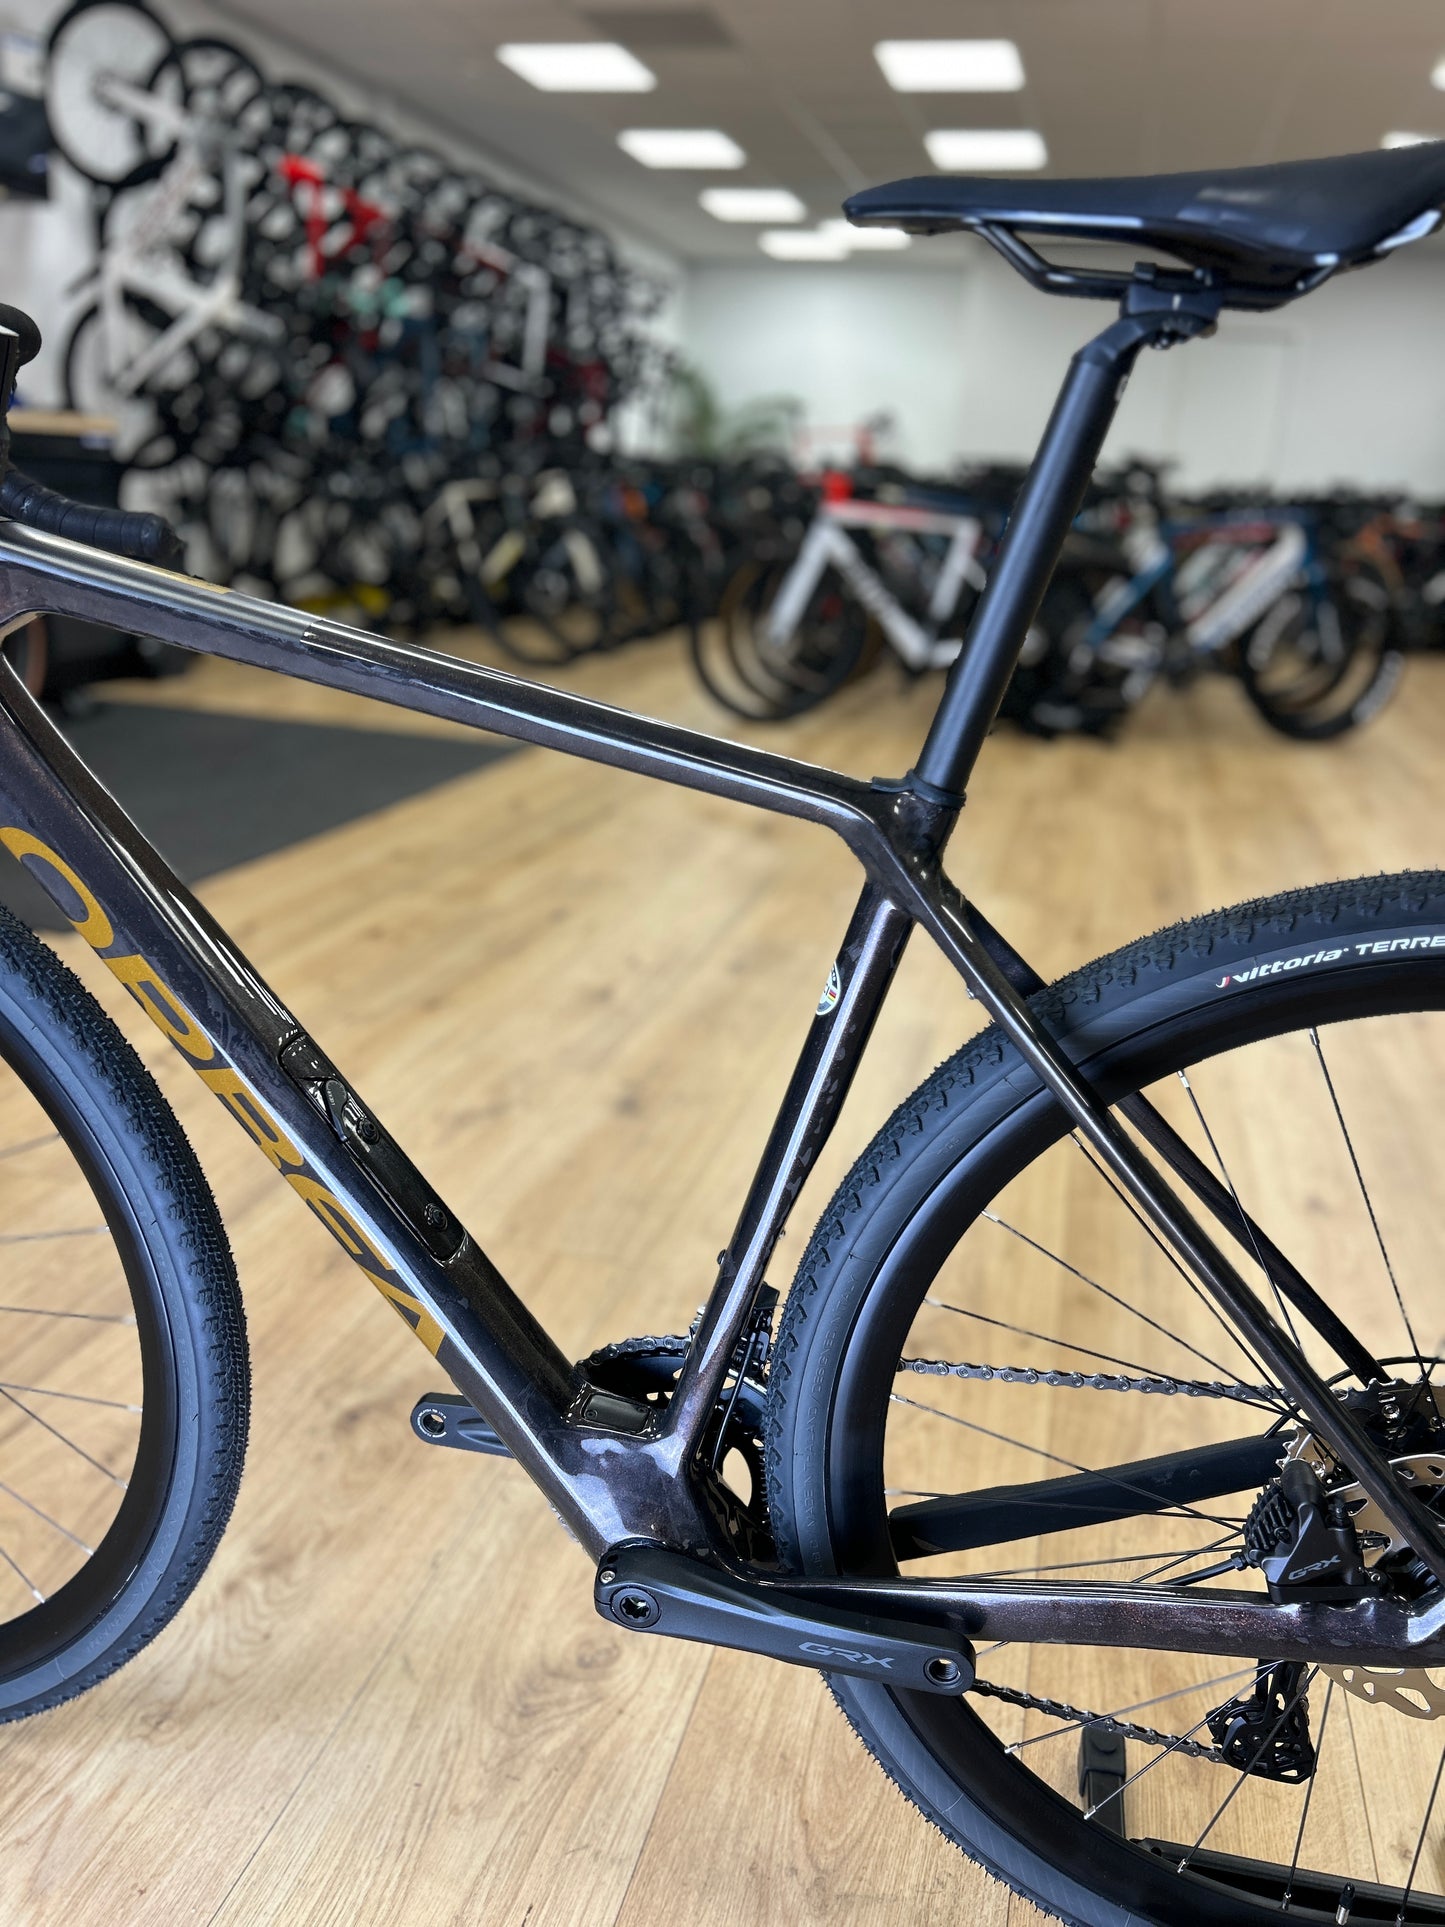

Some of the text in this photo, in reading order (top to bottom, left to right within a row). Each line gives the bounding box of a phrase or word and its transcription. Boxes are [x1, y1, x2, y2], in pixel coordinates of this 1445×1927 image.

[1355, 936, 1445, 955] TERRE
[0, 826, 446, 1357] ORBEA
[1288, 1555, 1341, 1580] GRX
[798, 1641, 896, 1669] GRX
